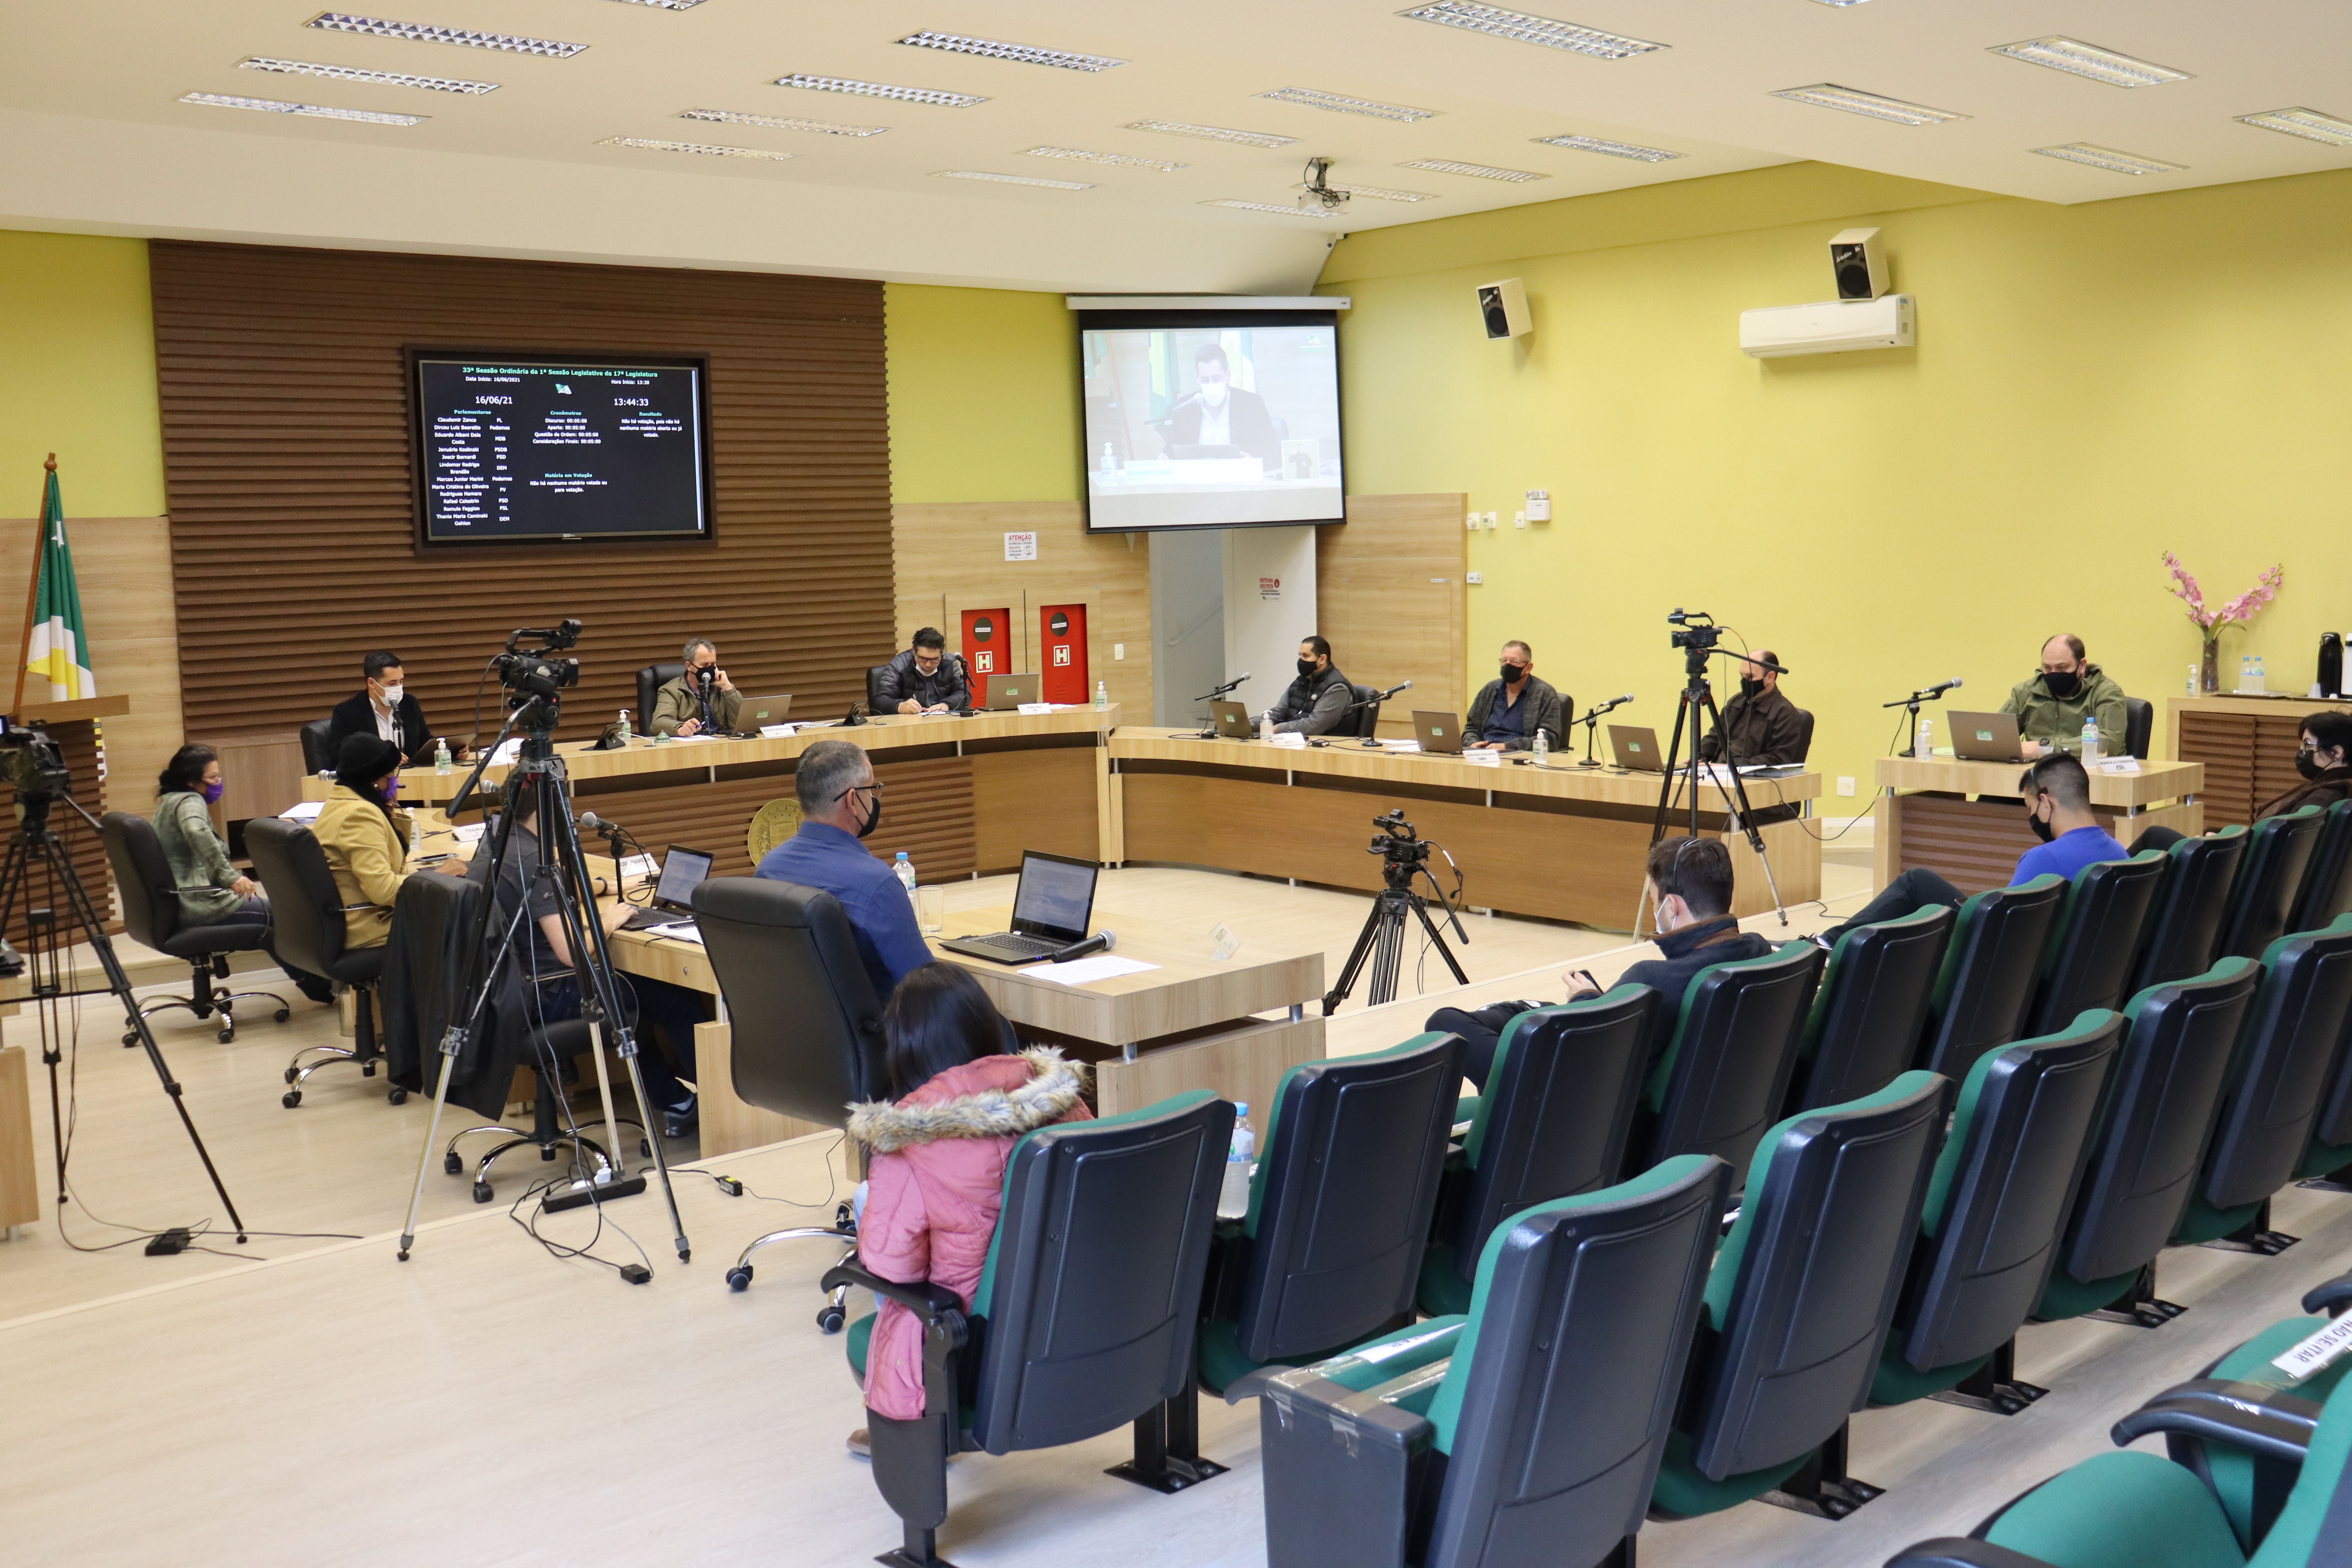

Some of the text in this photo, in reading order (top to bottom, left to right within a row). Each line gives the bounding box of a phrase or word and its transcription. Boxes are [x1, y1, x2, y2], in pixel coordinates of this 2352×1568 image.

[475, 396, 513, 405] 16/06/21
[614, 398, 649, 406] 13:44:33
[1056, 648, 1067, 663] H
[978, 654, 991, 670] H
